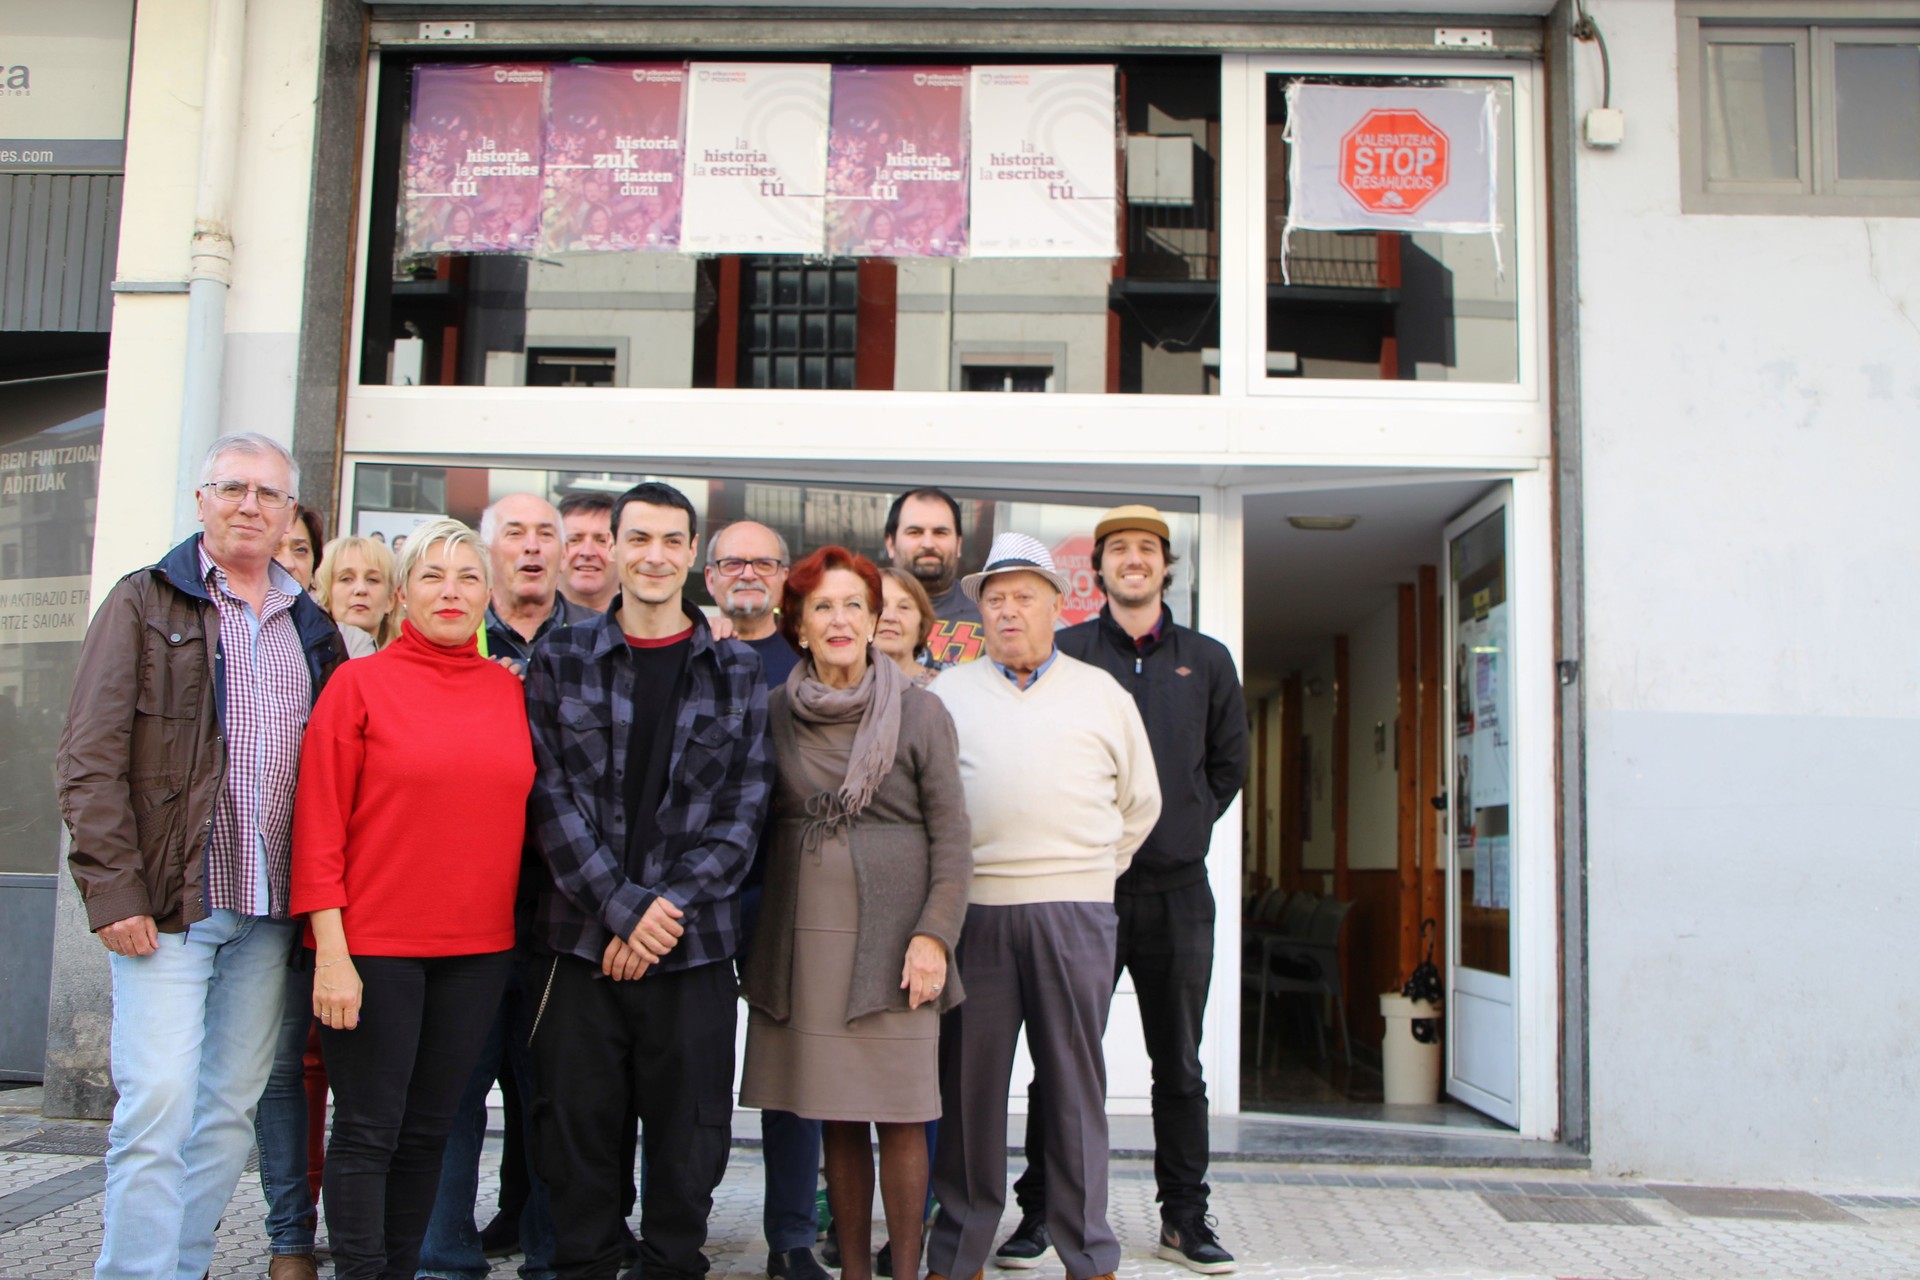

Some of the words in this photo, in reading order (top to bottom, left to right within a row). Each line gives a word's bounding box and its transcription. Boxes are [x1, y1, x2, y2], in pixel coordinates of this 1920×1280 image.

[482, 136, 496, 150] la
[615, 136, 679, 150] historia
[735, 136, 749, 150] la
[902, 139, 916, 153] la
[1021, 140, 1035, 153] la
[0, 150, 53, 162] es.com
[466, 148, 530, 162] historia
[593, 149, 639, 169] zuk
[704, 149, 767, 162] historia
[886, 152, 951, 167] historia
[990, 152, 1055, 166] historia
[1354, 146, 1436, 175] STOP
[455, 163, 469, 176] la
[472, 163, 540, 176] escribes
[614, 169, 673, 182] idazten
[693, 163, 706, 176] la
[710, 163, 777, 176] escribes
[875, 166, 889, 180] la
[892, 167, 961, 181] escribes
[979, 166, 993, 180] la
[997, 166, 1065, 180] escribes
[451, 176, 478, 196] tú
[620, 182, 658, 196] duzu
[759, 176, 785, 197] tú
[1353, 175, 1434, 190] DESAHUCIOS
[870, 180, 898, 201] tú
[1048, 180, 1074, 200] tú
[0, 452, 27, 470] REN
[3, 472, 66, 494] ADITUAK
[11, 590, 67, 607] AKTIBAZIO
[71, 590, 90, 605] ETA
[1, 615, 29, 630] RTZE
[33, 613, 75, 629] SAIOAK
